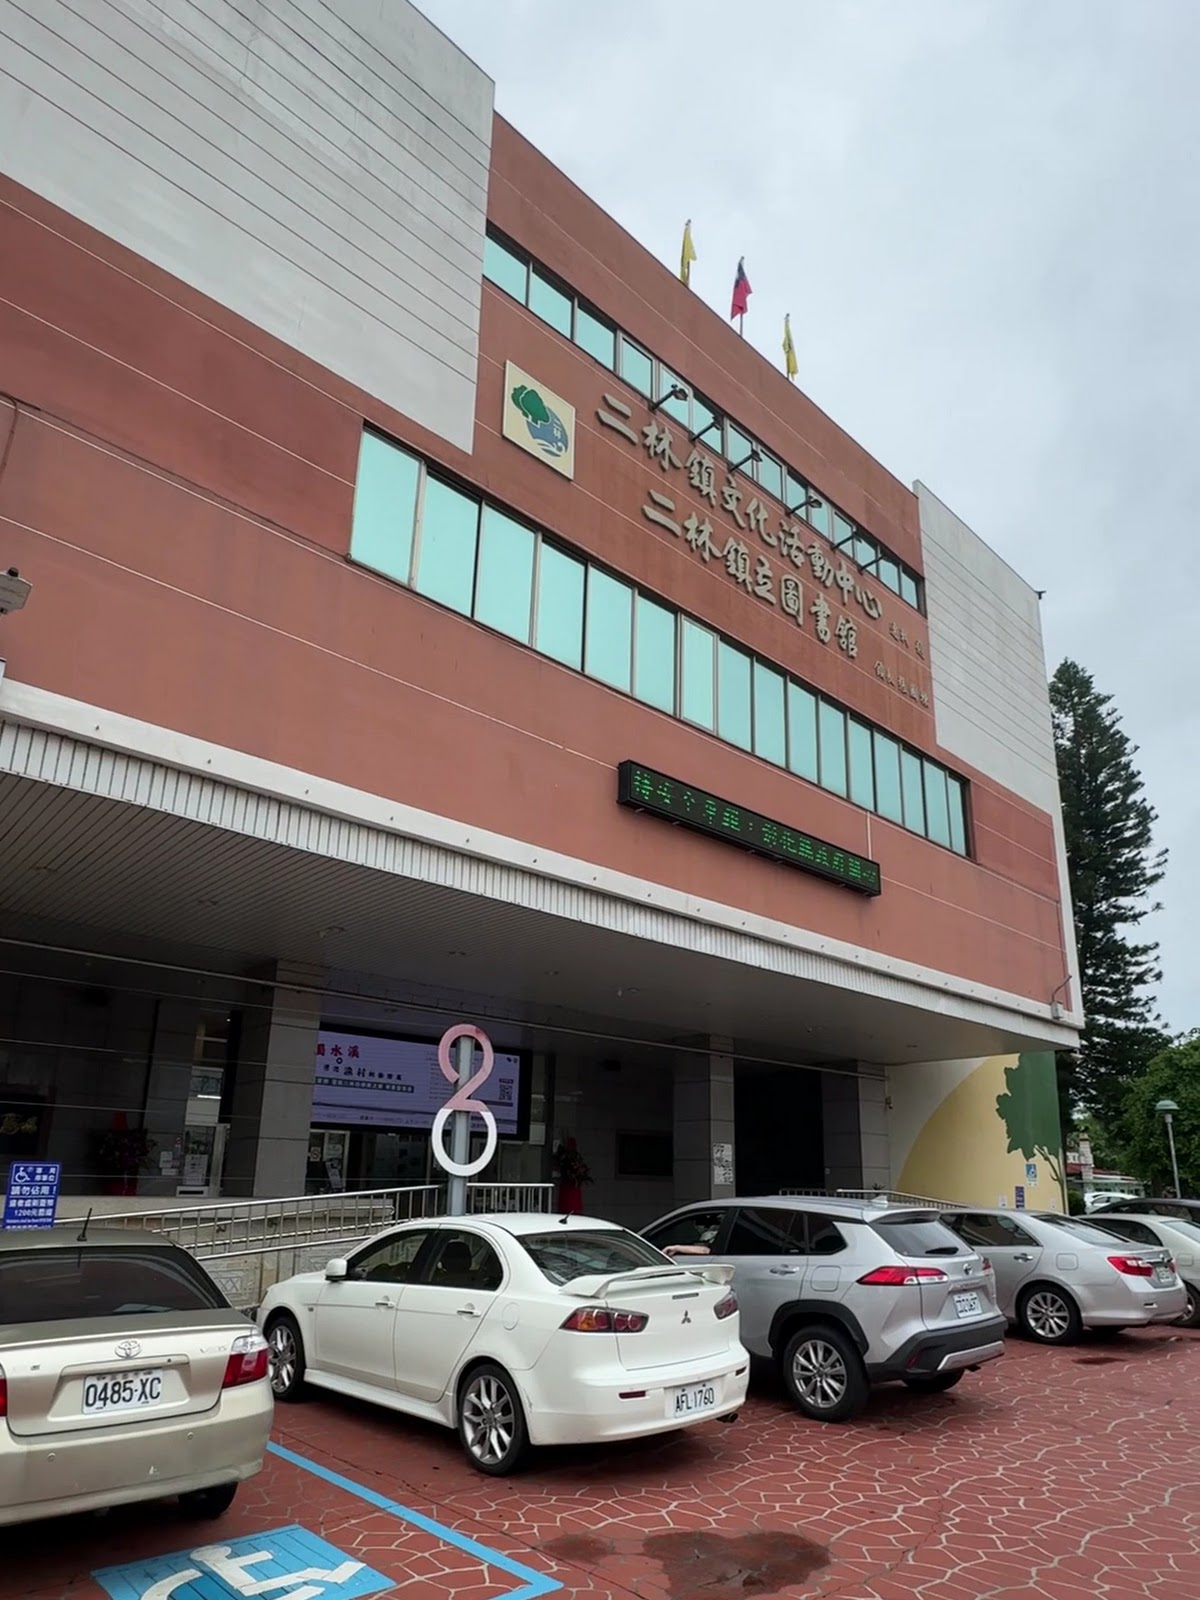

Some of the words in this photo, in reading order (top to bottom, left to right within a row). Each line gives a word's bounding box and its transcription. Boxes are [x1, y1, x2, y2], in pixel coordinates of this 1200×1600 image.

[595, 393, 883, 619] 二林鎮文化活動中心
[642, 488, 860, 660] 二林鎮立圖書館
